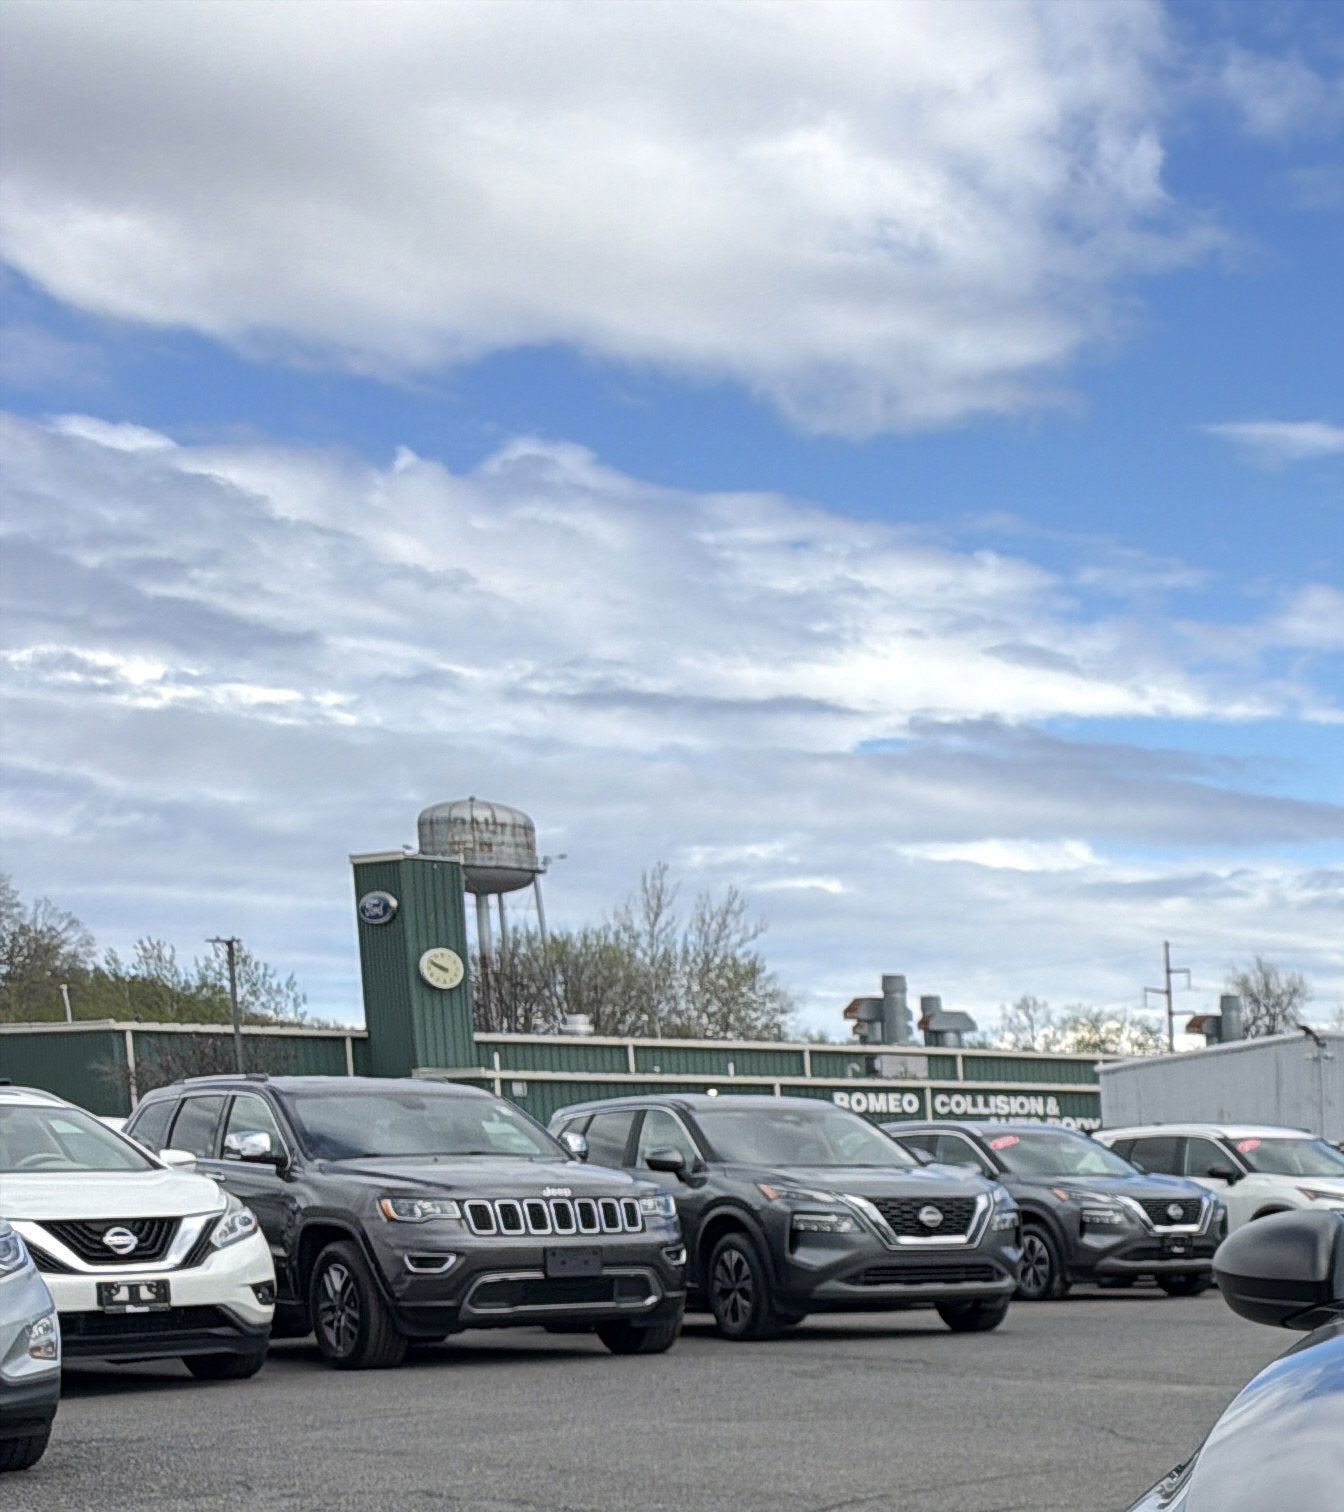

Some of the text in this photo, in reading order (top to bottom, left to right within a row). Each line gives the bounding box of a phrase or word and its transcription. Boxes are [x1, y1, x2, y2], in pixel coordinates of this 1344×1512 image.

[832, 1091, 1061, 1117] ROMEO COLLISION &
